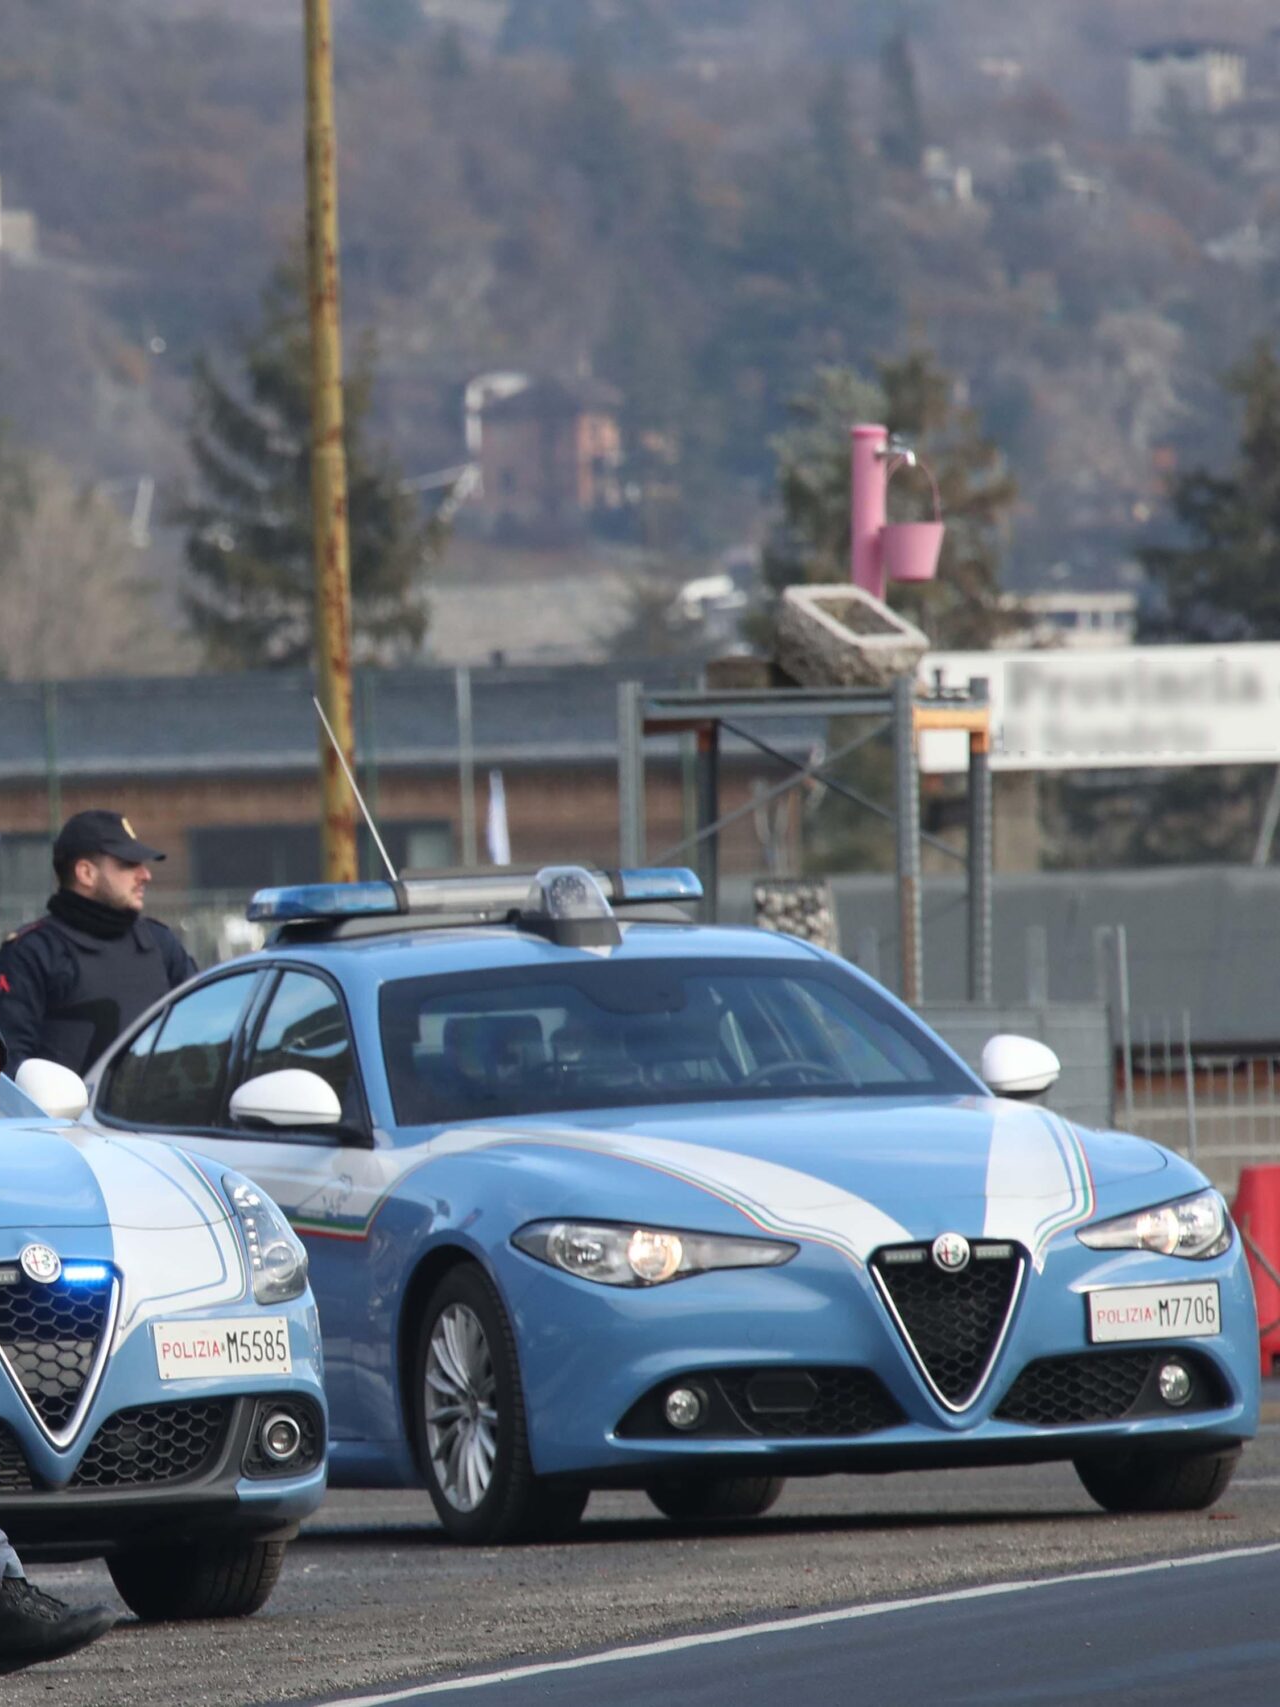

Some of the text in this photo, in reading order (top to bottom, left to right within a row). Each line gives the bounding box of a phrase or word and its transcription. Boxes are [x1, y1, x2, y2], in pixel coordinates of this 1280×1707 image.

[1097, 1296, 1216, 1327] POLIZIA M7706
[162, 1330, 287, 1364] POLIZIA M5585
